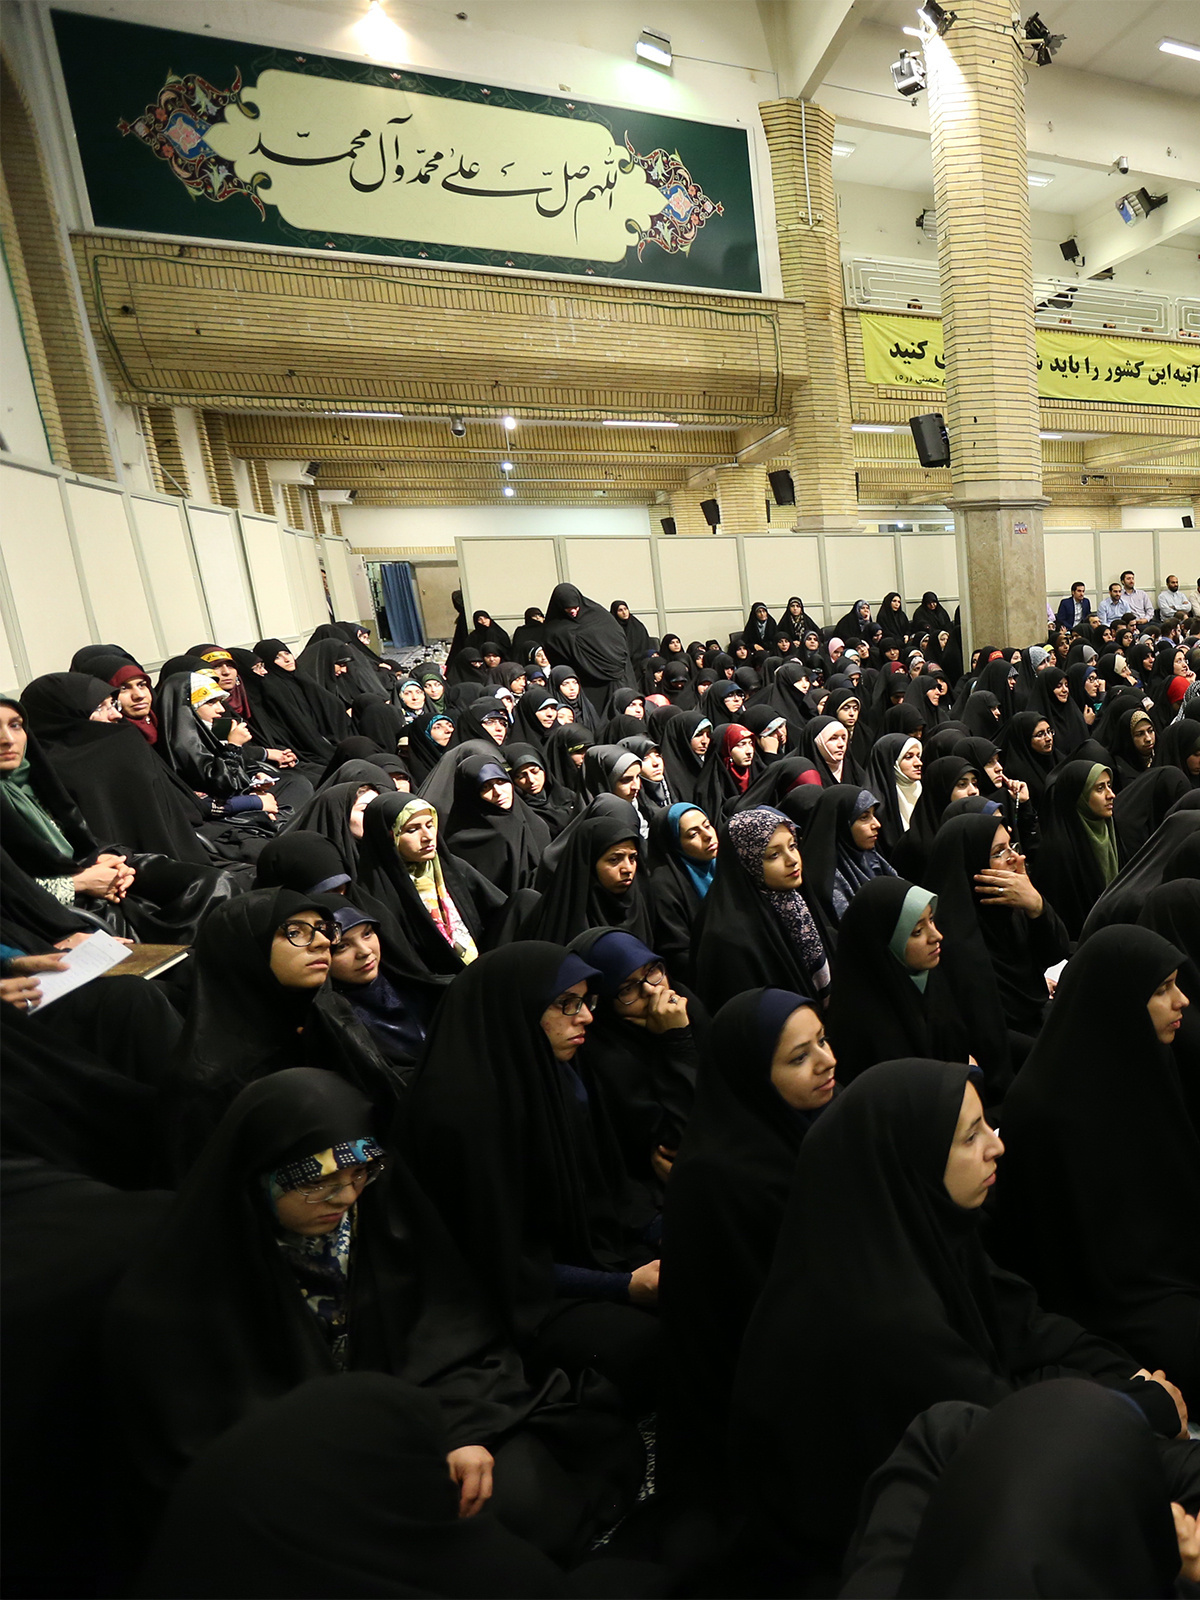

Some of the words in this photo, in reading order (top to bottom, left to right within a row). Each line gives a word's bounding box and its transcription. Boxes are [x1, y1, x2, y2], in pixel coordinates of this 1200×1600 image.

[889, 340, 929, 365] کنید
[1049, 355, 1080, 379] باید
[1084, 356, 1100, 381] را
[1104, 360, 1145, 382] کشور
[1147, 363, 1172, 386] این
[915, 375, 940, 385] خمینی
